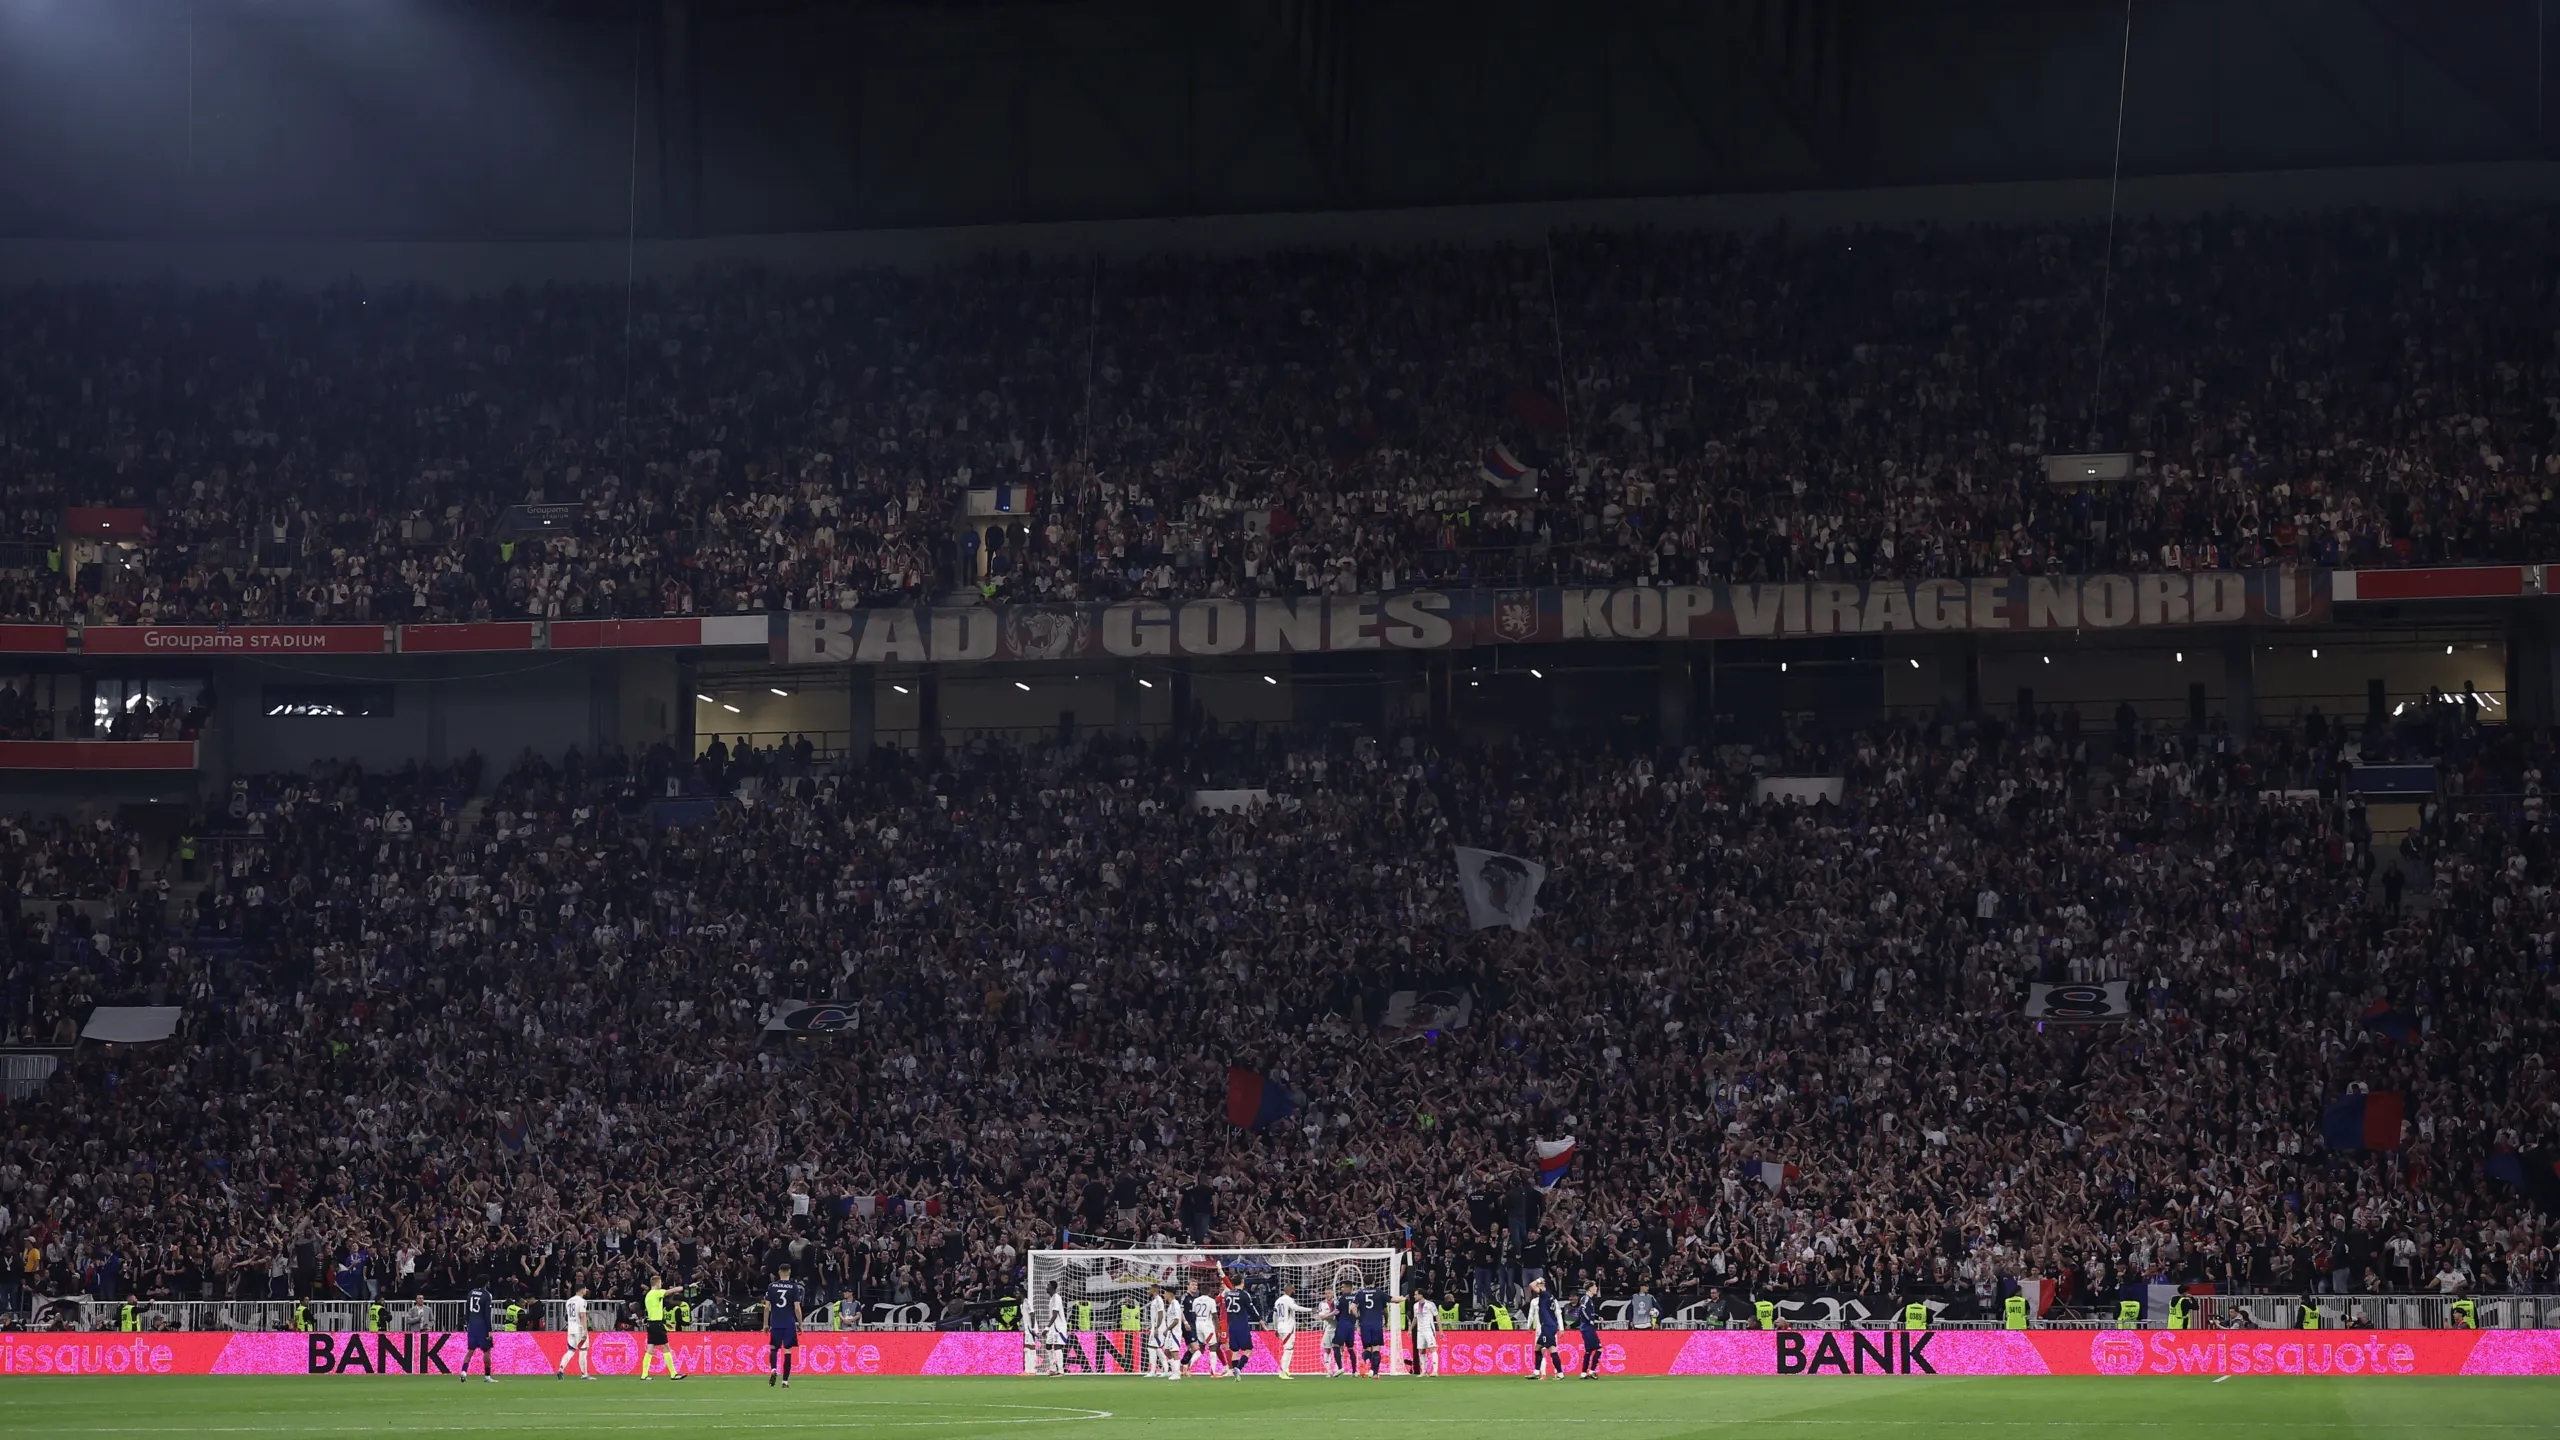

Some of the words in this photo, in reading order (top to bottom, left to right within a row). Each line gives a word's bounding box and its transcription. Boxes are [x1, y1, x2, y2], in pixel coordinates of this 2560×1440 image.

[527, 506, 569, 515] Groupama
[787, 605, 998, 664] BAD
[1102, 592, 1453, 657] GONES
[1562, 585, 1714, 639] KOP
[1728, 577, 2010, 640] VIRAGE
[2028, 573, 2246, 628] NORD
[144, 630, 244, 650] Groupama
[250, 634, 326, 647] STADIUM
[469, 1296, 481, 1313] 13
[776, 1289, 788, 1308] 3
[1226, 1296, 1241, 1313] 25
[1365, 1293, 1374, 1309] 5
[568, 1303, 577, 1317] 18
[1196, 1303, 1207, 1317] 22
[0, 1335, 173, 1375] issquote
[308, 1333, 451, 1374] BANK
[1777, 1332, 1937, 1374] BANK
[2150, 1331, 2415, 1375] Swissquote
